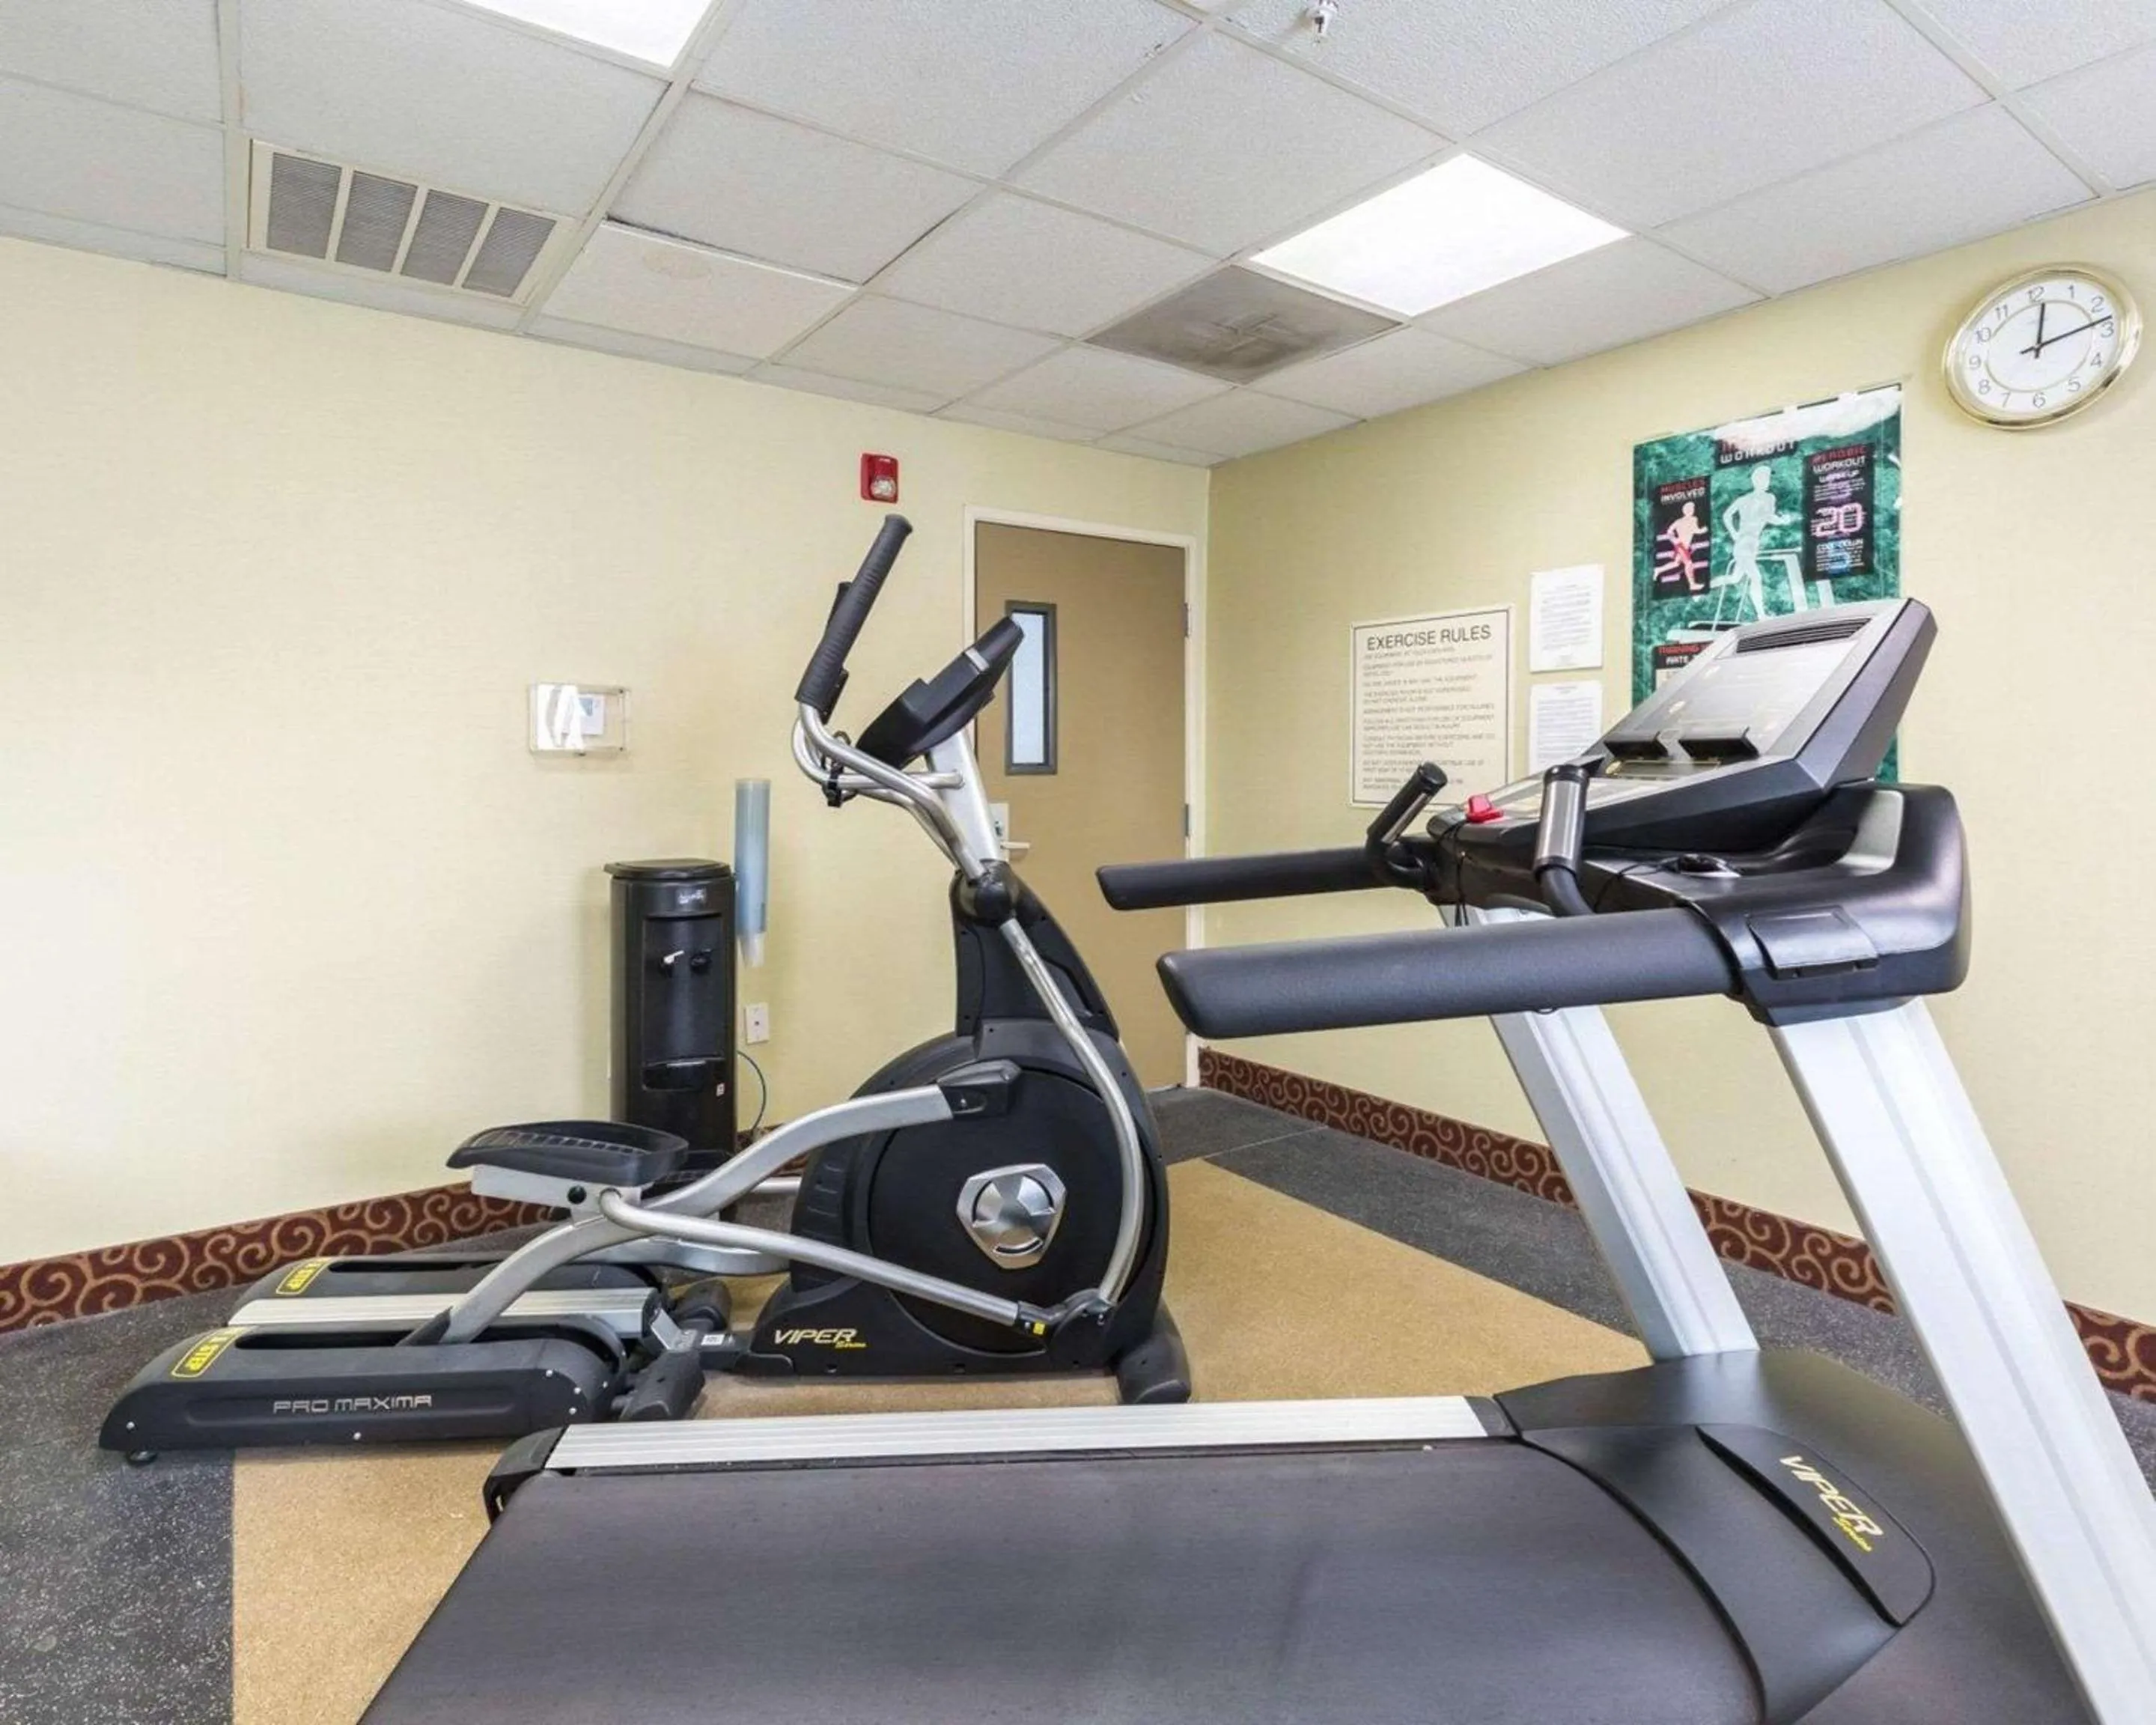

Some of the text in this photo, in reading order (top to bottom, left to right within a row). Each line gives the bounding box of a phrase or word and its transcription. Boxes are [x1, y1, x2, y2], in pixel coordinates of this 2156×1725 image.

[2027, 286, 2044, 303] 12
[2068, 285, 2074, 299] 1
[1995, 304, 2009, 320] 11
[2090, 295, 2104, 313] 2
[1976, 326, 1992, 344] 10
[2101, 320, 2114, 338] 3
[1969, 355, 1982, 370] 9
[2089, 352, 2104, 368] 4
[1977, 379, 1991, 395] 8
[2067, 377, 2081, 393] 5
[2001, 392, 2012, 408] 7
[2032, 392, 2046, 409] 6
[1812, 455, 1866, 475] WORKOUT
[1660, 487, 1706, 503] INVOLVED
[1814, 502, 1863, 538] 20
[1367, 624, 1492, 651] EXERCISE RULES
[775, 1328, 857, 1345] VIPER
[273, 1395, 432, 1414] PRO MAXIMA
[1779, 1455, 1884, 1536] VIPER
